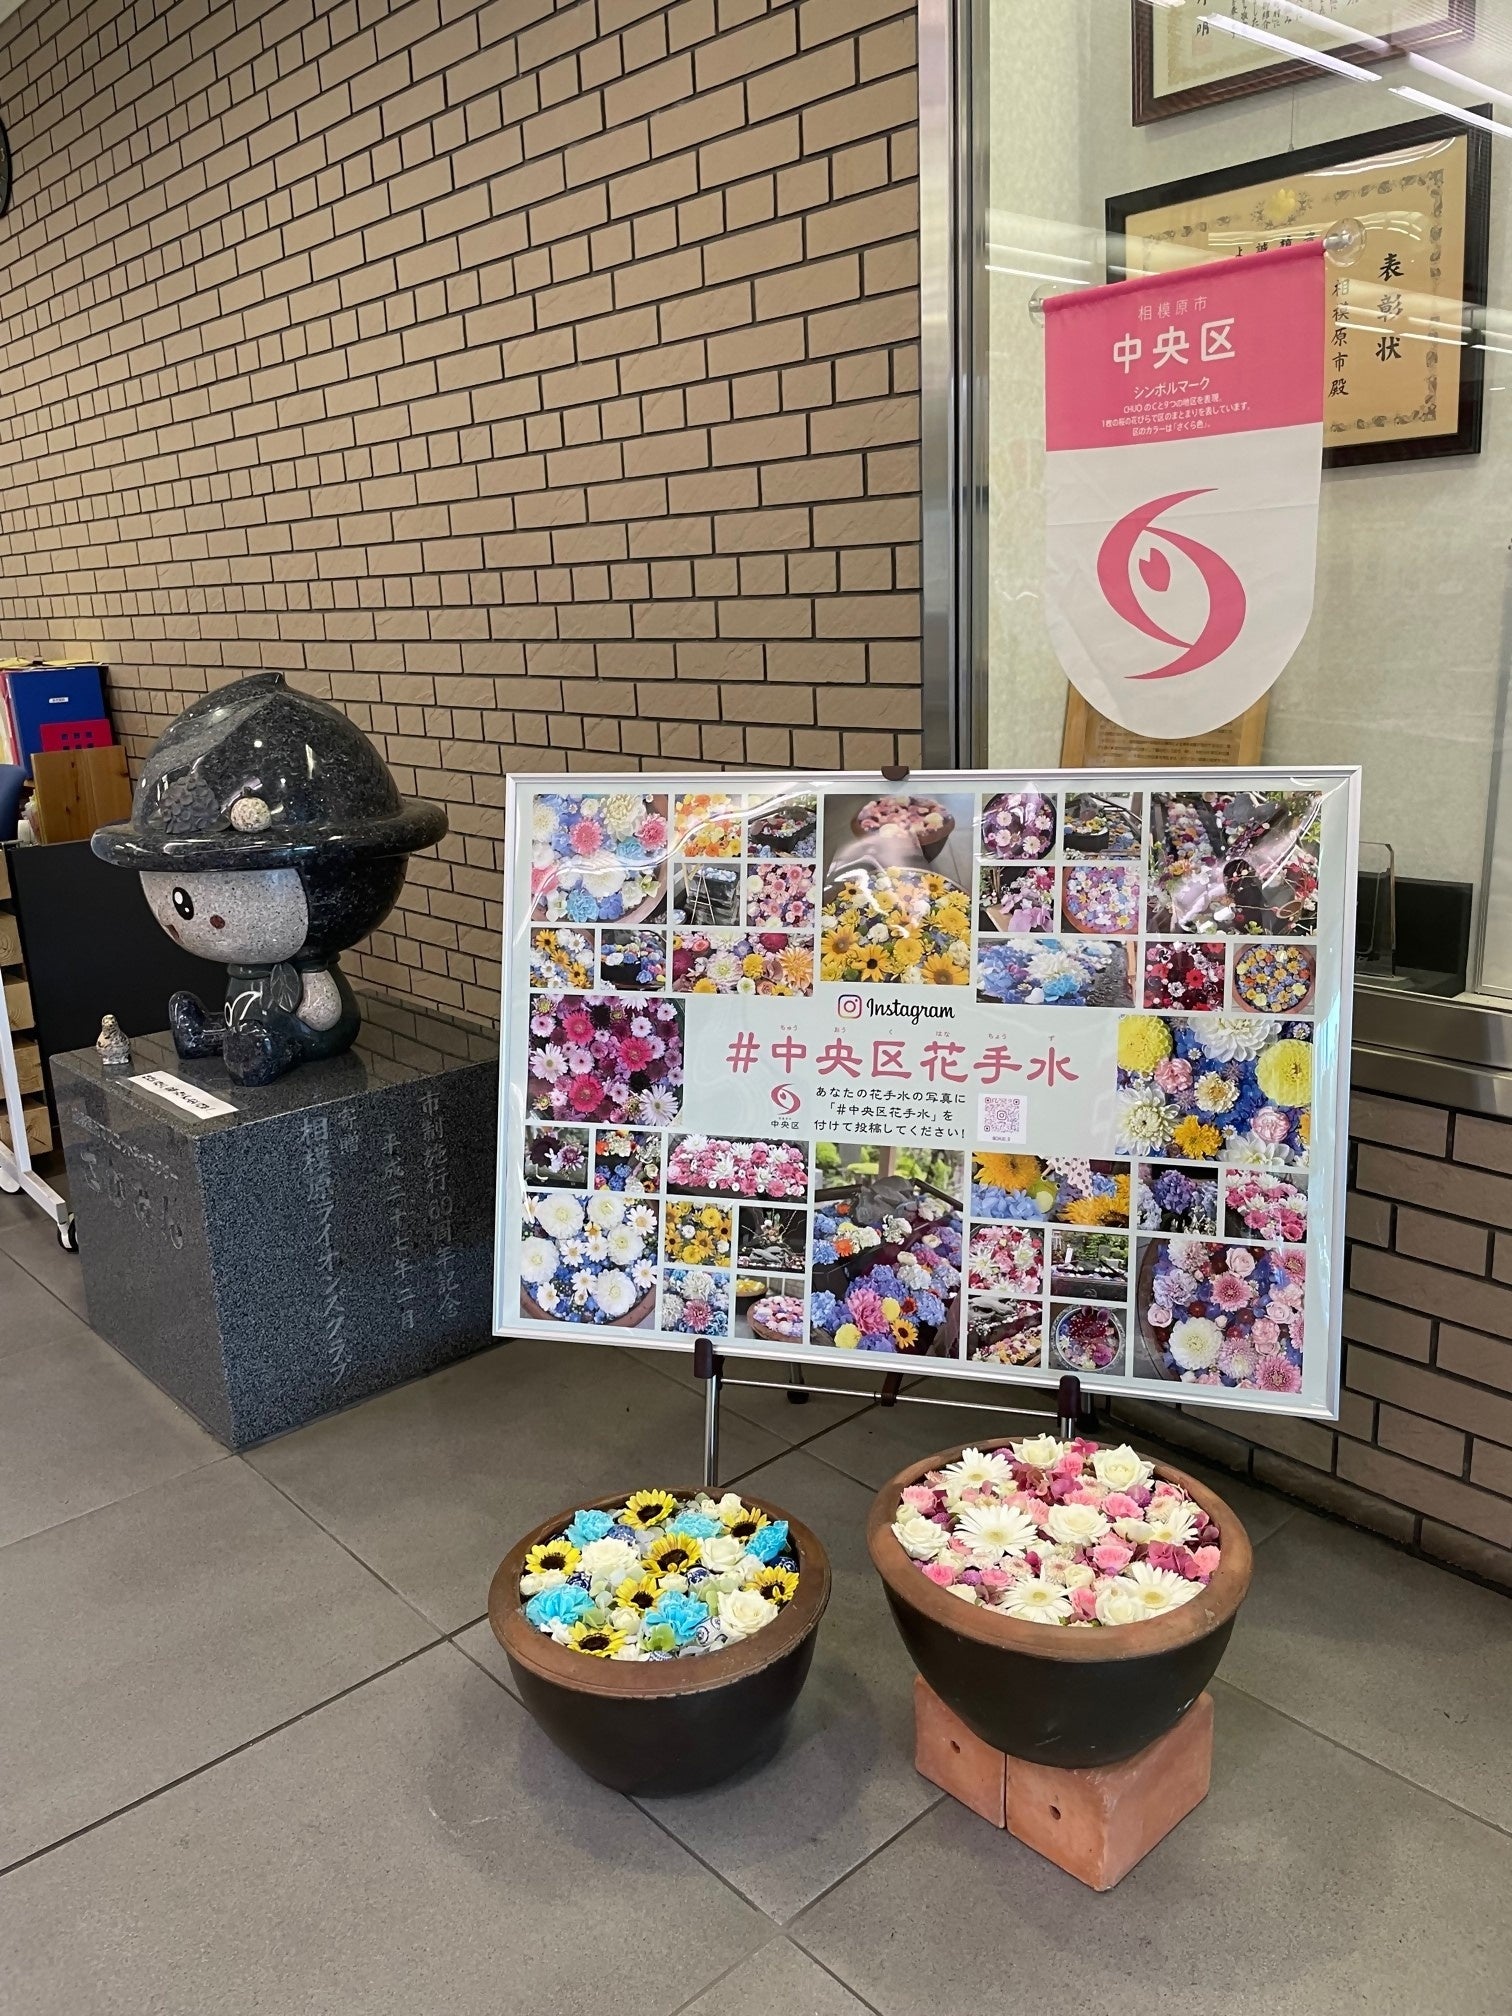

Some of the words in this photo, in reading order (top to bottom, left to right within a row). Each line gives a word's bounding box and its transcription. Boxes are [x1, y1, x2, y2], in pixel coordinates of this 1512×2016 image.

[1138, 295, 1208, 322] 相模原市
[1375, 253, 1405, 362] 表彰状
[1113, 317, 1236, 374] 中央区
[1328, 278, 1350, 398] 相模原市殿
[1133, 376, 1210, 400] シンボルマーク
[866, 998, 955, 1025] Instagram
[726, 1031, 1080, 1087] #中央区花手水
[816, 1086, 966, 1104] あなたの花手水の写真に
[770, 1119, 799, 1129] 中央区
[829, 1101, 953, 1122] 「#中央区花手水」を
